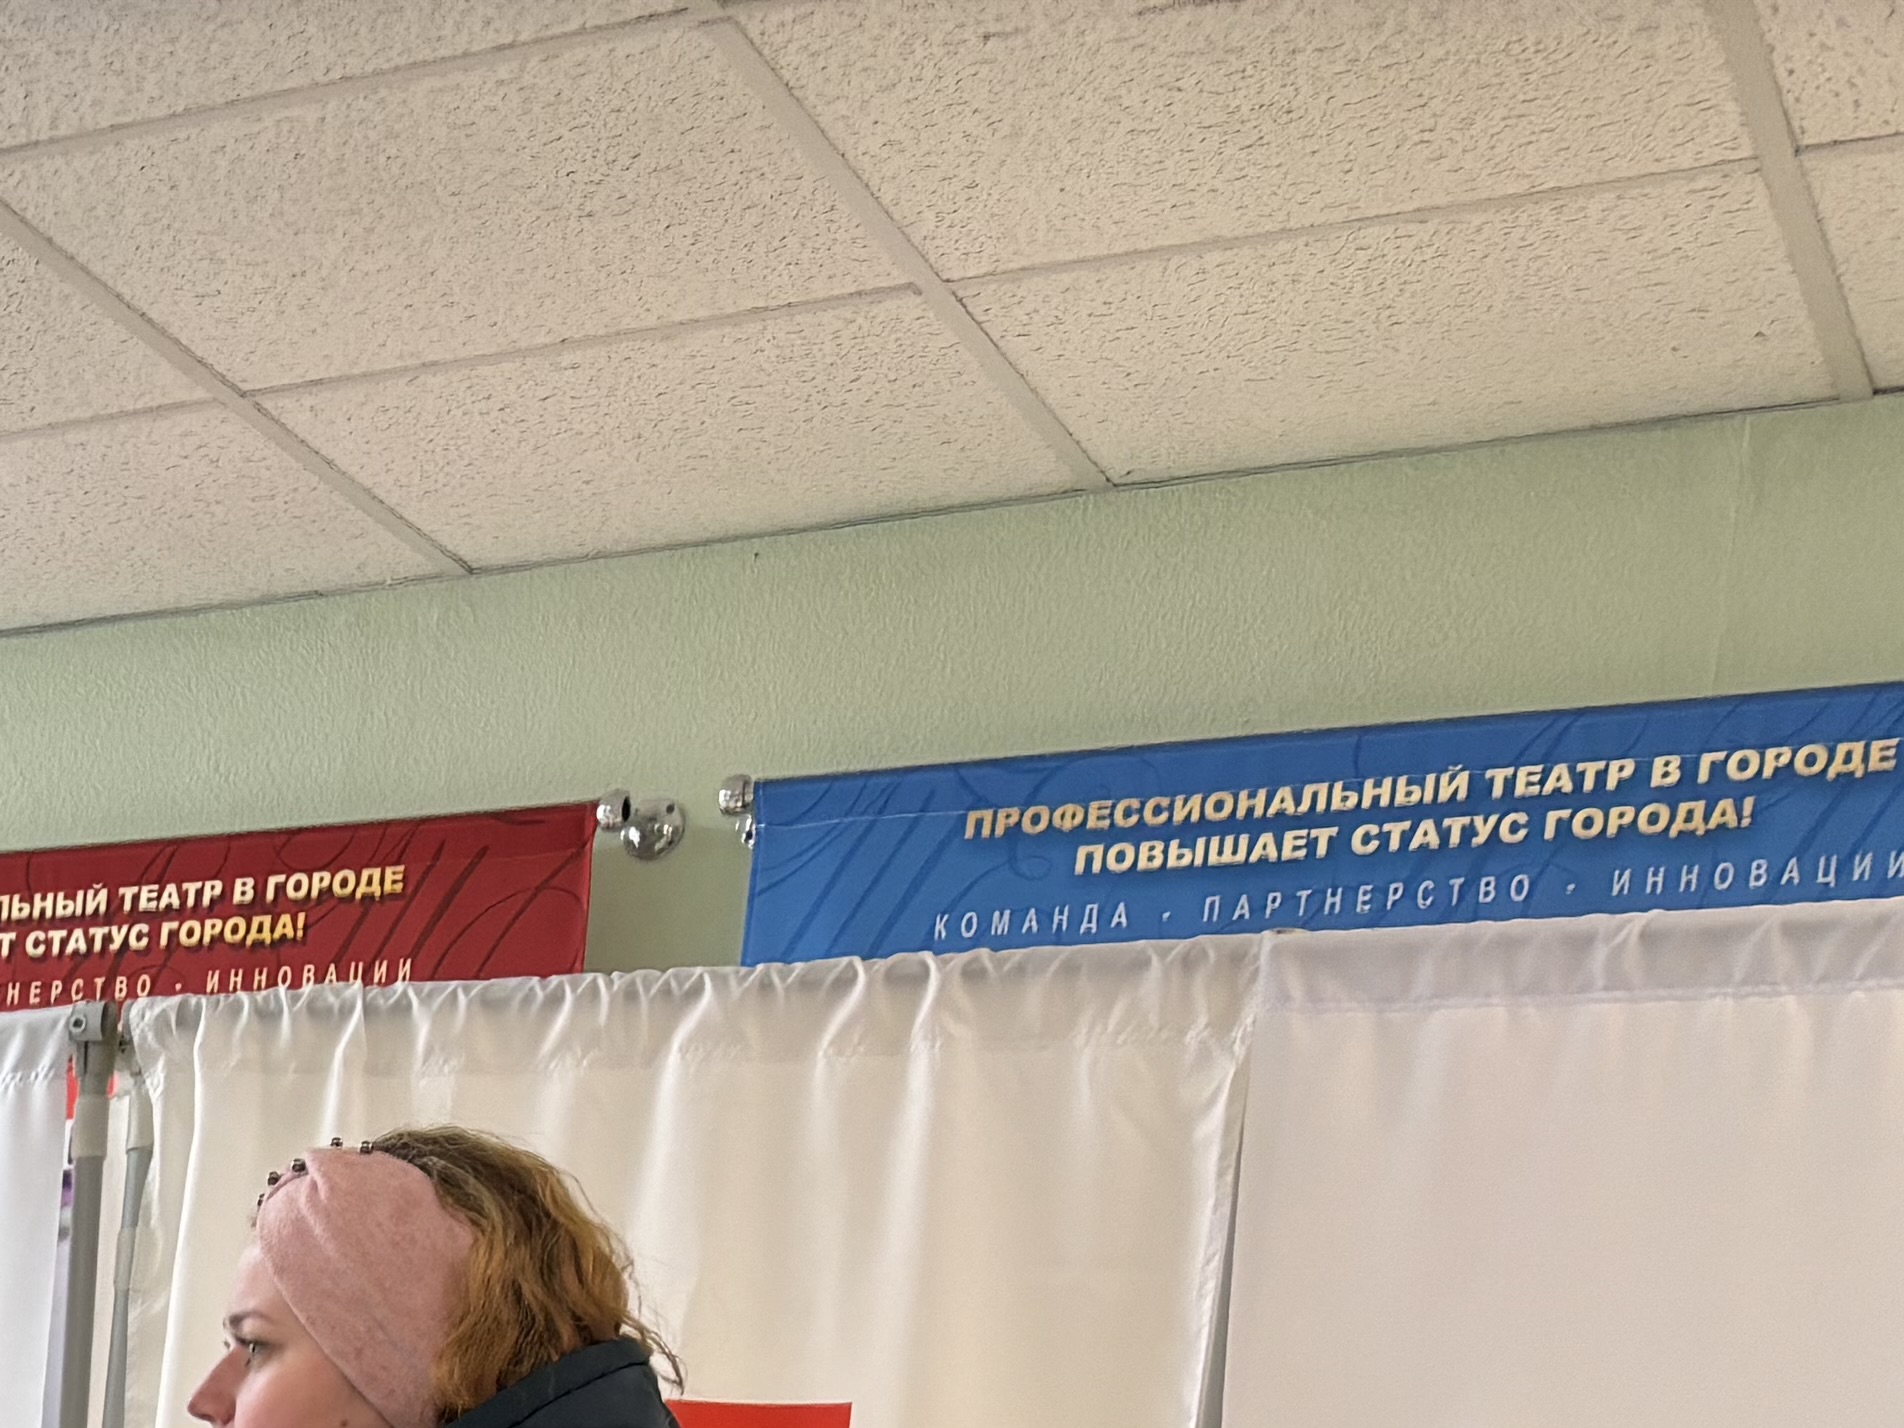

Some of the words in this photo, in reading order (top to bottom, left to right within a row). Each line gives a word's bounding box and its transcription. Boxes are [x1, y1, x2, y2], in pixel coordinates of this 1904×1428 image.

[964, 765, 1470, 839] ПРОФЕССИОНАЛЬНЫЙ
[1485, 758, 1635, 799] ТЕАТР
[1650, 755, 1681, 788] В
[1697, 737, 1899, 785] ГОРОДЕ
[1074, 827, 1338, 876] ПОВЫШАЕТ
[1351, 811, 1529, 855] СТАТУС
[1543, 796, 1756, 840] ГОРОДА!
[120, 880, 223, 914] ТЕАТР
[233, 877, 255, 906] В
[266, 865, 405, 904] ГОРОДЕ
[934, 902, 1129, 940] КОМАНДА
[1203, 873, 1529, 923] ПАРТНЕРСТВО
[1611, 850, 1904, 896] ИННОВАЦИИ
[25, 922, 149, 958] СТАТУС
[160, 912, 307, 949] ГОРОДА!
[206, 958, 412, 994] ИННОВАЦИИ
